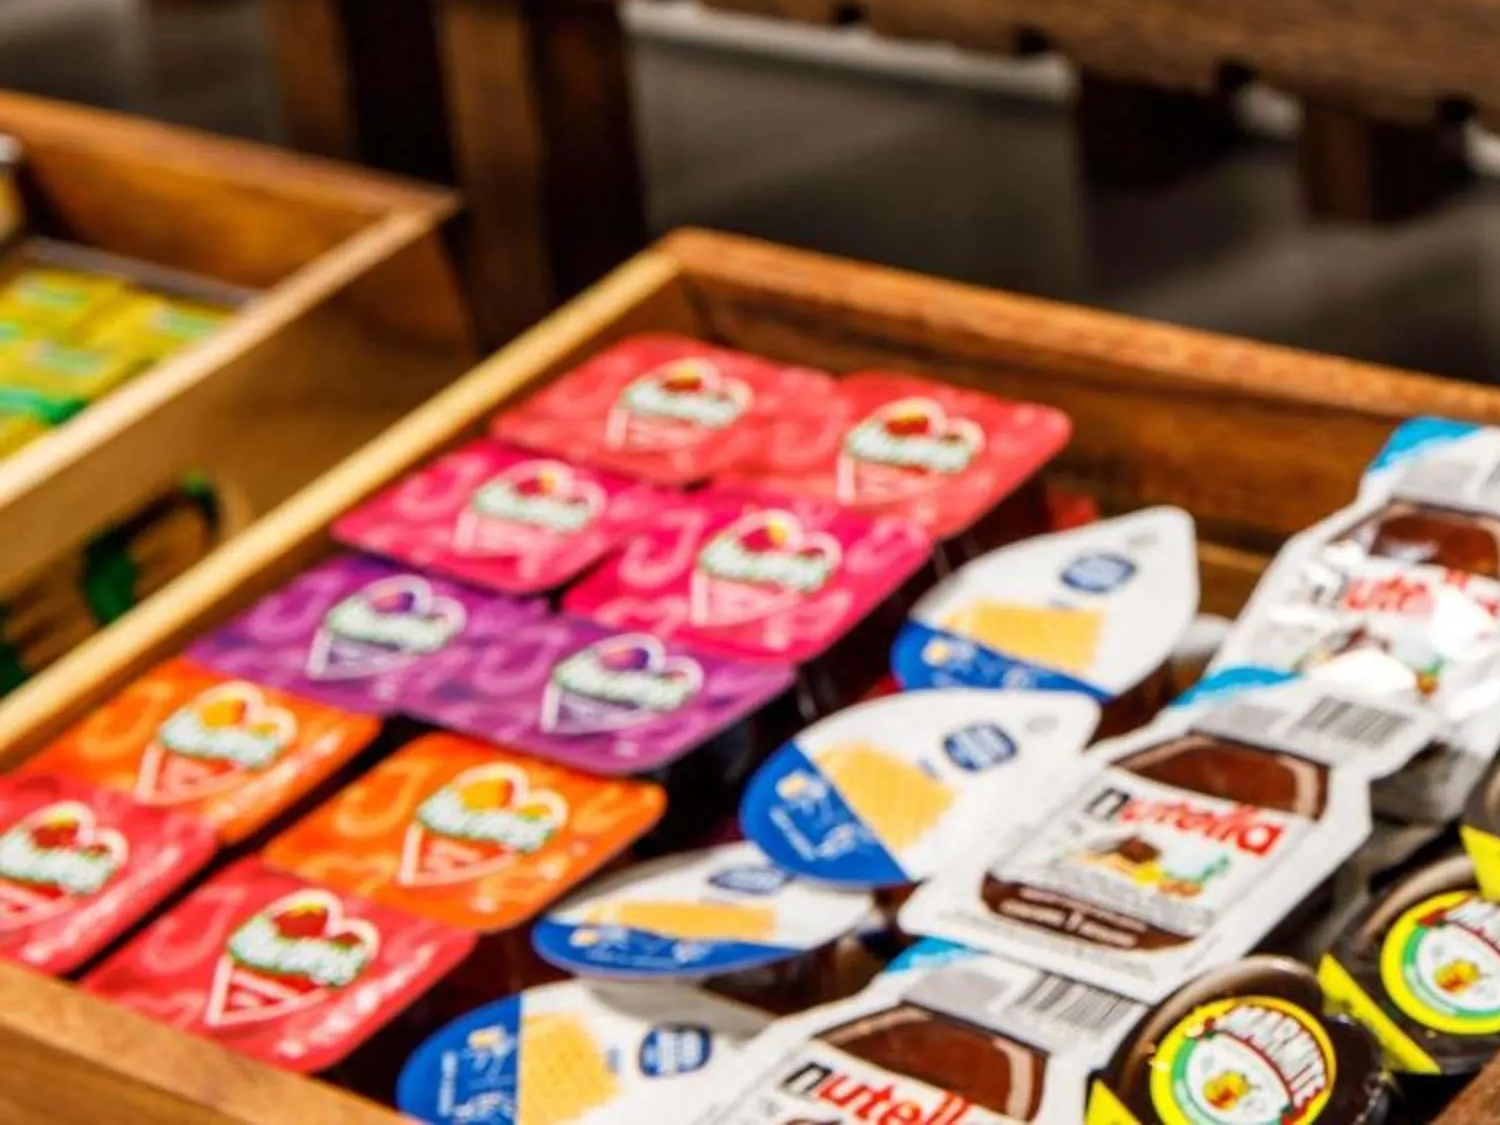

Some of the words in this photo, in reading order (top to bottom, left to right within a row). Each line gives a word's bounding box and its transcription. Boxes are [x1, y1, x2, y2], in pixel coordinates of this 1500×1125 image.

[1084, 786, 1286, 857] nutella
[1214, 1003, 1328, 1110] MARMITE
[779, 1061, 976, 1125] nutell
